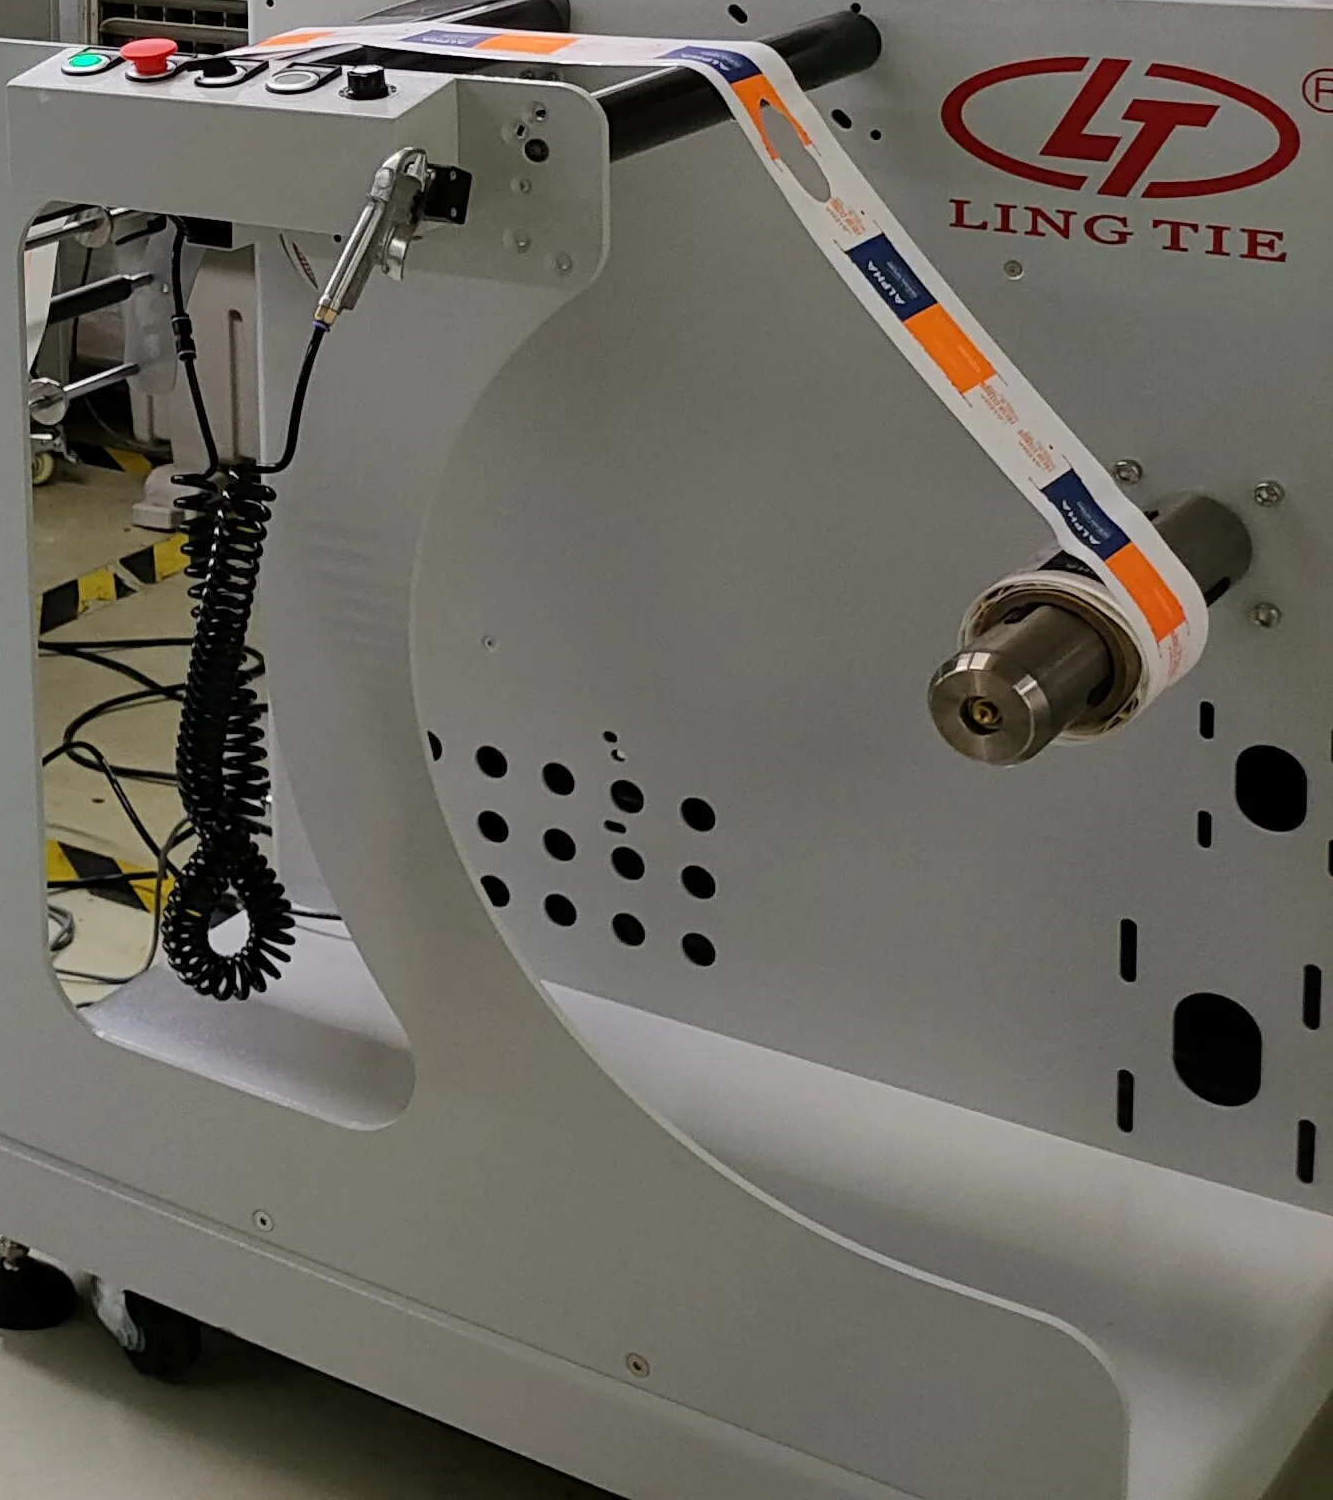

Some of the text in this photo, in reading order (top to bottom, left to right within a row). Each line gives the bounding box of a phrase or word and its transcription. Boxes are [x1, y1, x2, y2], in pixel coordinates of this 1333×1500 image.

[949, 199, 1287, 262] LING TIE
[867, 260, 906, 304] ALPHA
[1061, 499, 1102, 545] ALPHA
